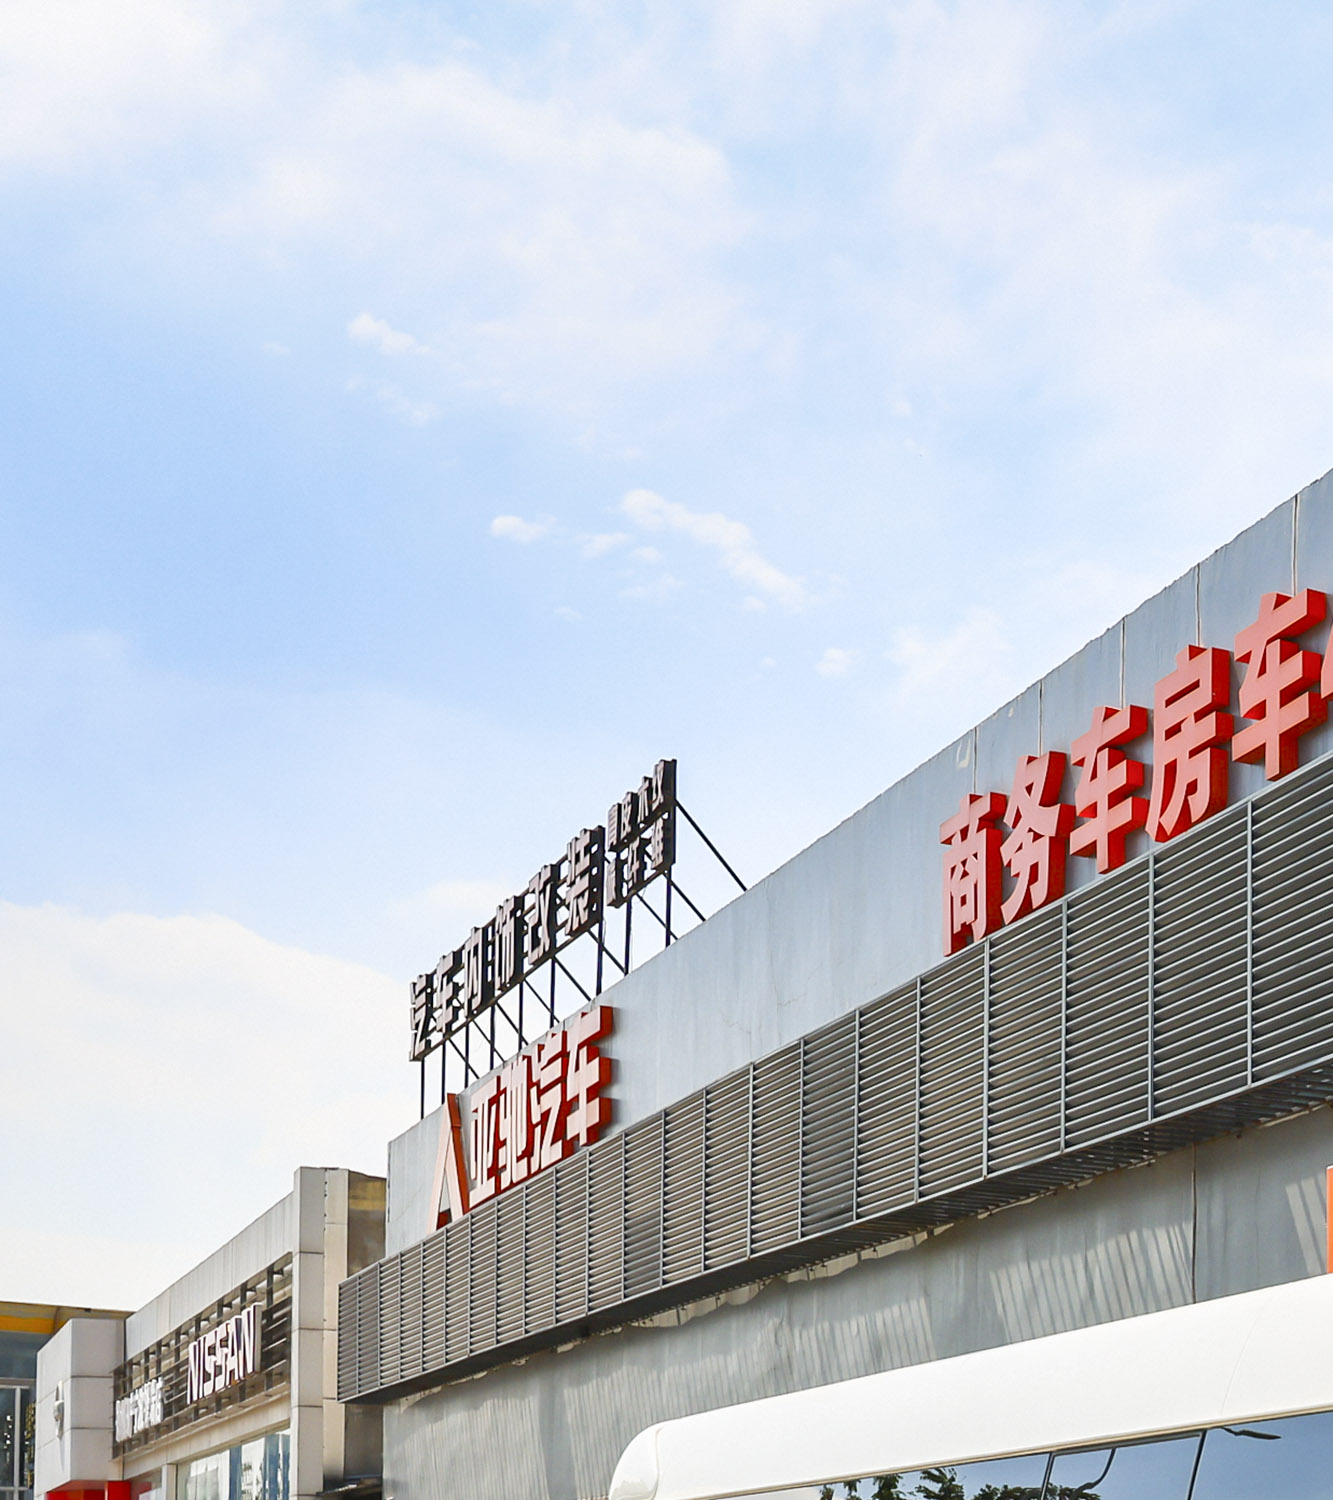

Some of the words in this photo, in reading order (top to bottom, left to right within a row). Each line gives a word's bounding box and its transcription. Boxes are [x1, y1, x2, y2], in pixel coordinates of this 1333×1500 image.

[409, 826, 603, 1061] 汽车内饰改装
[468, 1006, 613, 1207] 亚驰汽车
[187, 1302, 262, 1405] NISSAN
